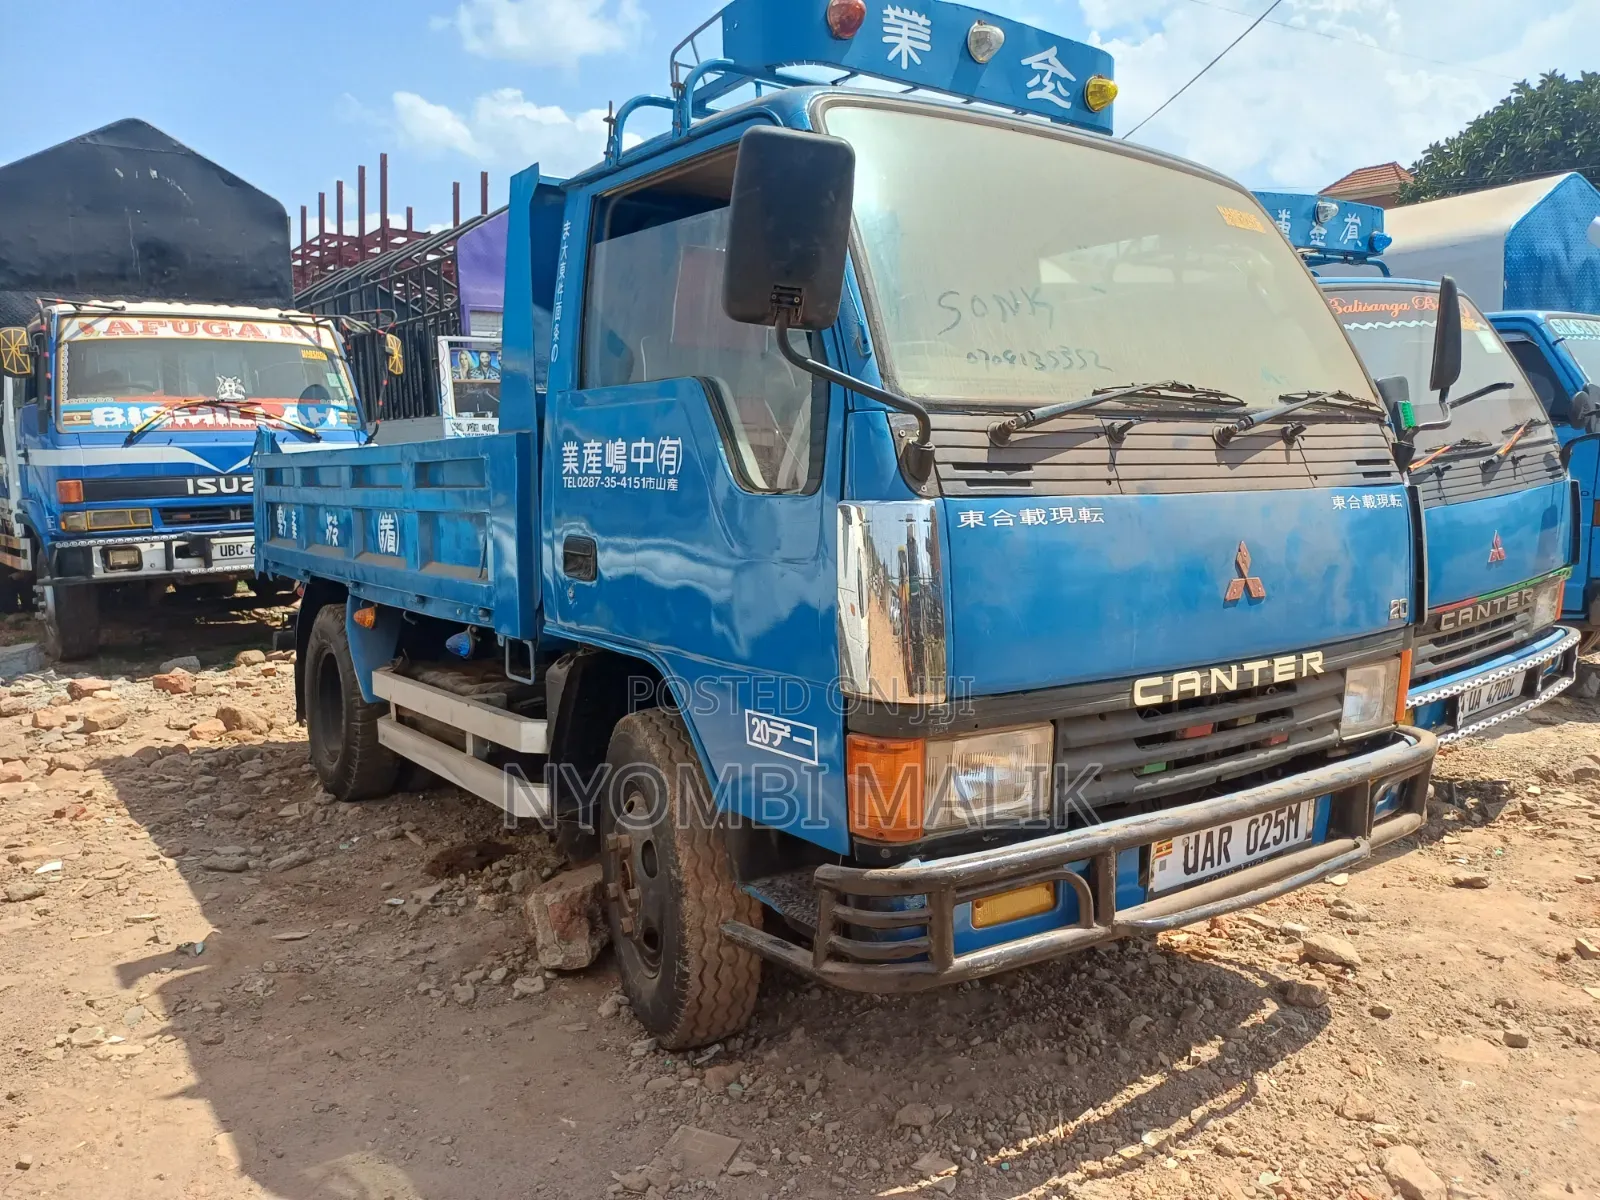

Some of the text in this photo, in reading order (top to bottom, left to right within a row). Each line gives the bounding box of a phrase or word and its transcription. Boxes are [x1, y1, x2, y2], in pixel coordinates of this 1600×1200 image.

[1389, 598, 1408, 620] 20
[1440, 588, 1534, 631] CANTER
[1133, 650, 1325, 706] CANTER
[1183, 803, 1301, 876] UAR 025M
